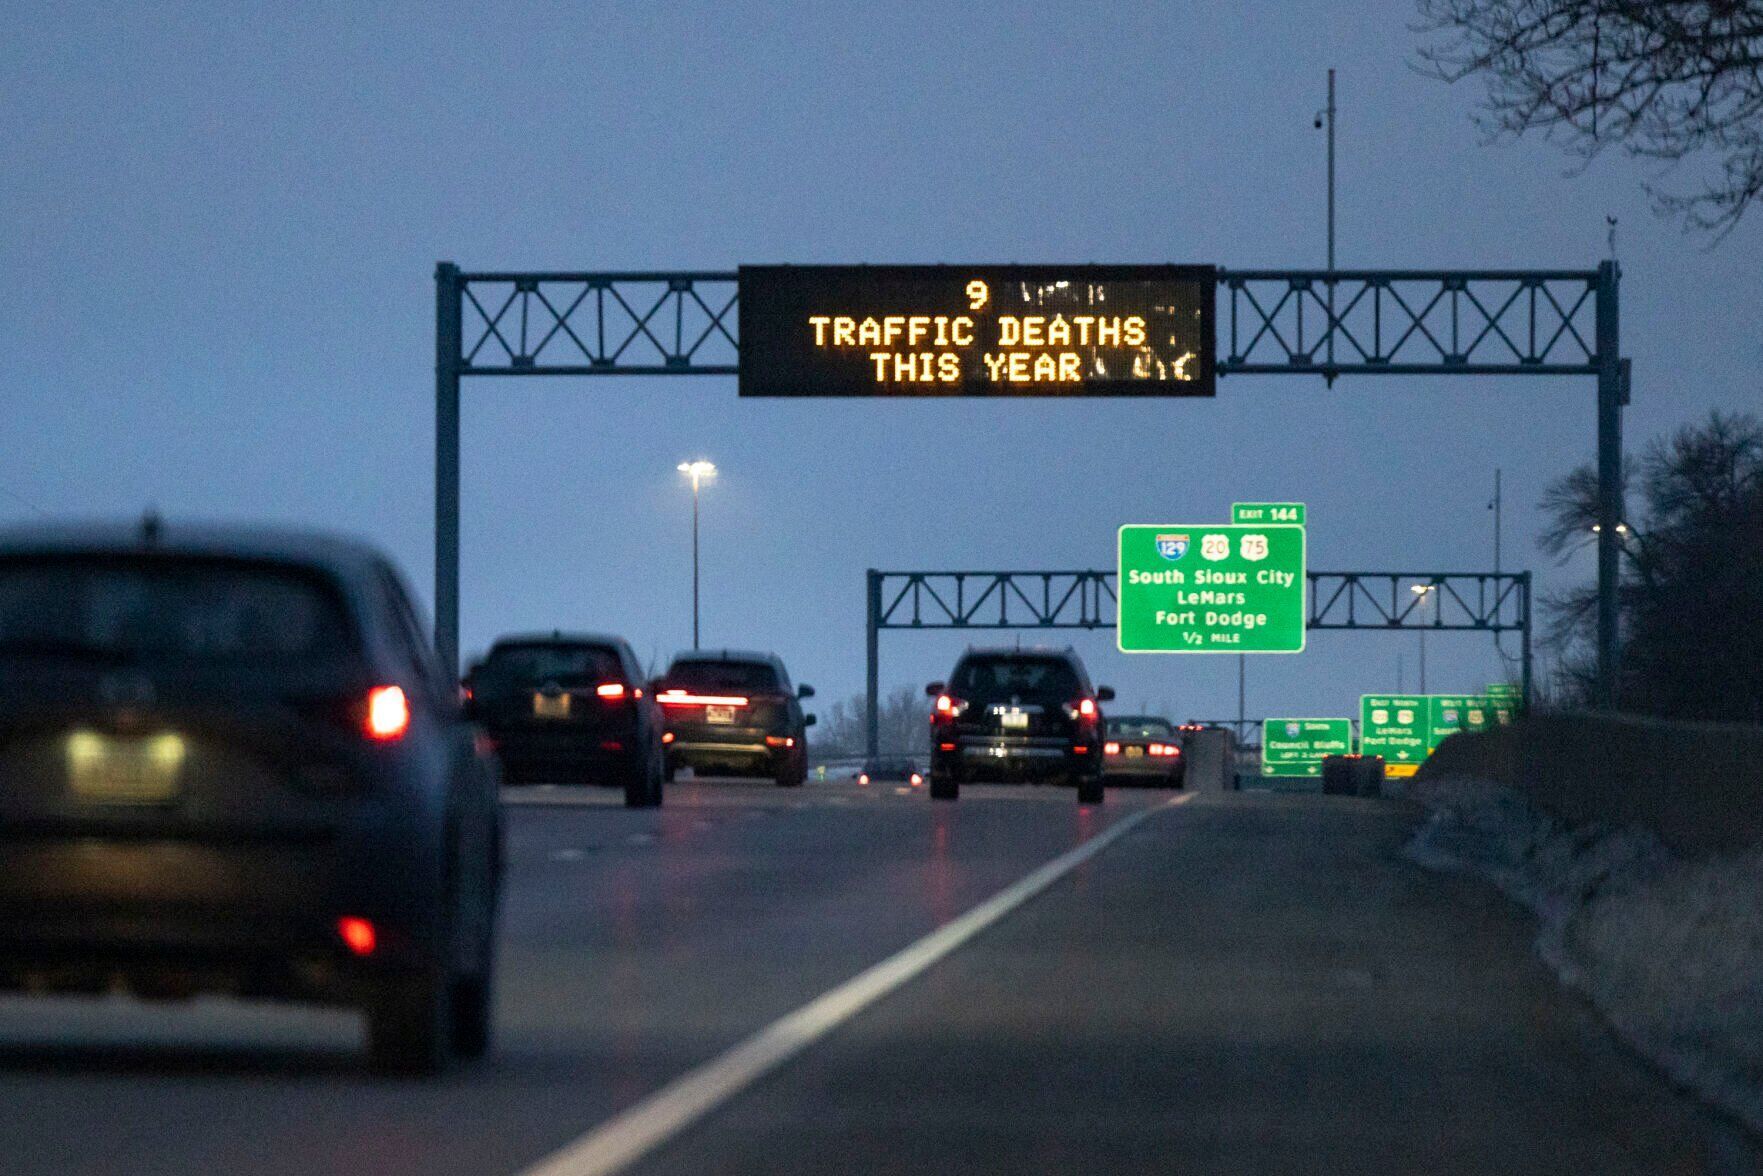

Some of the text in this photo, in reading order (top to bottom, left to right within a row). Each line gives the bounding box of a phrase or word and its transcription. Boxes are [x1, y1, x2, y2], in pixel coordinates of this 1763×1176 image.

[966, 280, 988, 308] 9
[809, 316, 1146, 345] TRAFFIC DEATHS
[870, 352, 1080, 383] THIS YEAR
[1239, 508, 1297, 521] EXIT 144
[1161, 542, 1186, 555] 129
[1206, 541, 1225, 555] 20
[1246, 541, 1265, 555] 75
[1129, 569, 1294, 588] South Sioux City
[1177, 591, 1245, 605] LeMars
[1156, 611, 1267, 629] Fort Dodge
[1211, 633, 1240, 643] MILE
